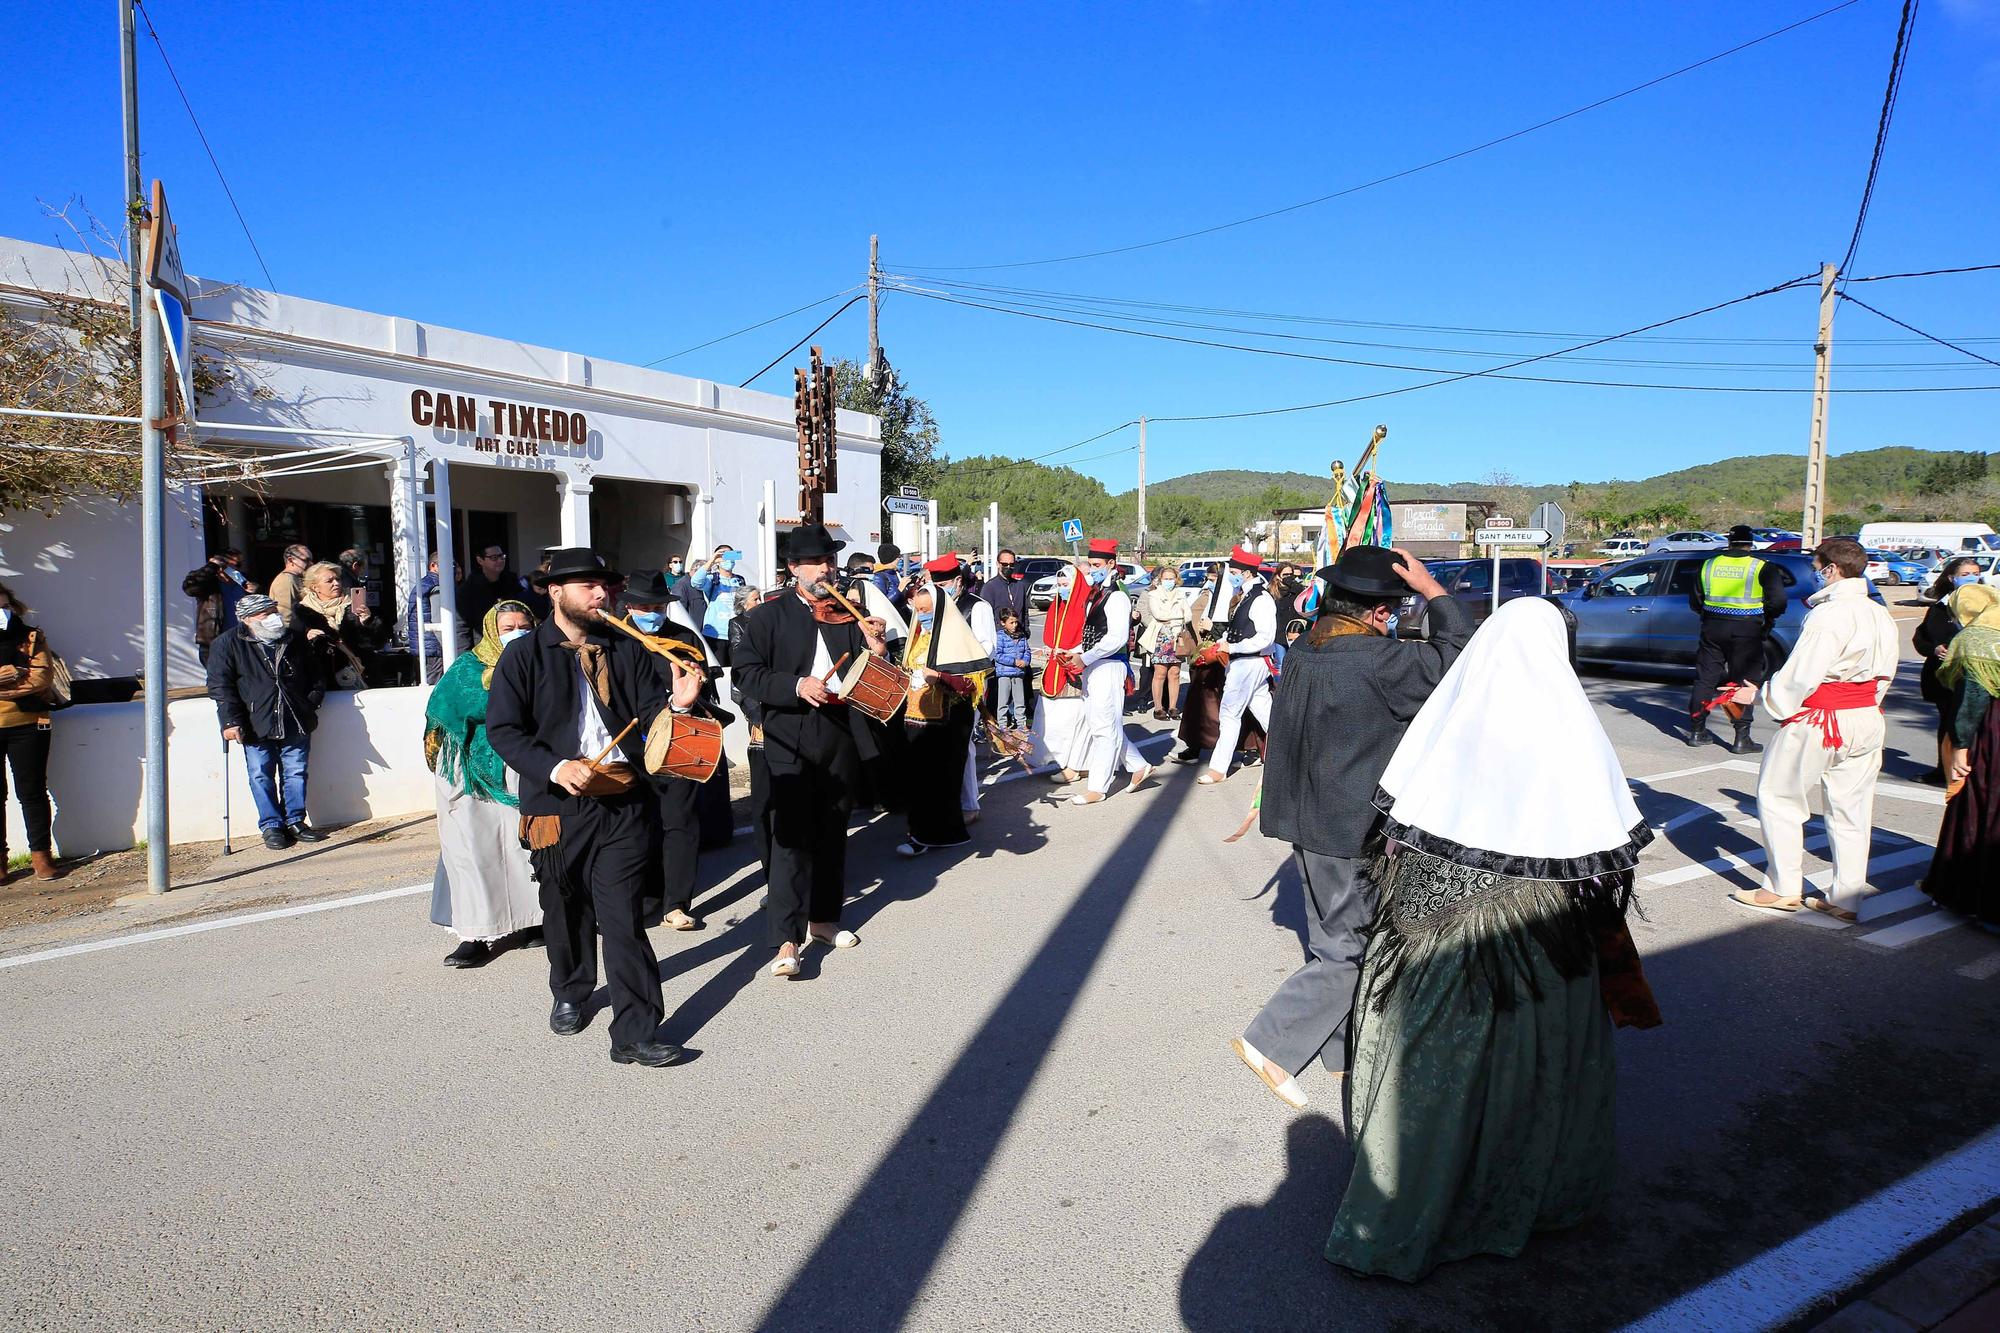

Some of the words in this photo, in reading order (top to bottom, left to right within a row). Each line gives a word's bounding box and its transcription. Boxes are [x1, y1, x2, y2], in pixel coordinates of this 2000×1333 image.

[411, 389, 476, 432] CAN
[488, 400, 587, 445] TIXEDO
[475, 437, 500, 453] ART
[506, 439, 539, 457] CAFE
[894, 501, 908, 509] SANT
